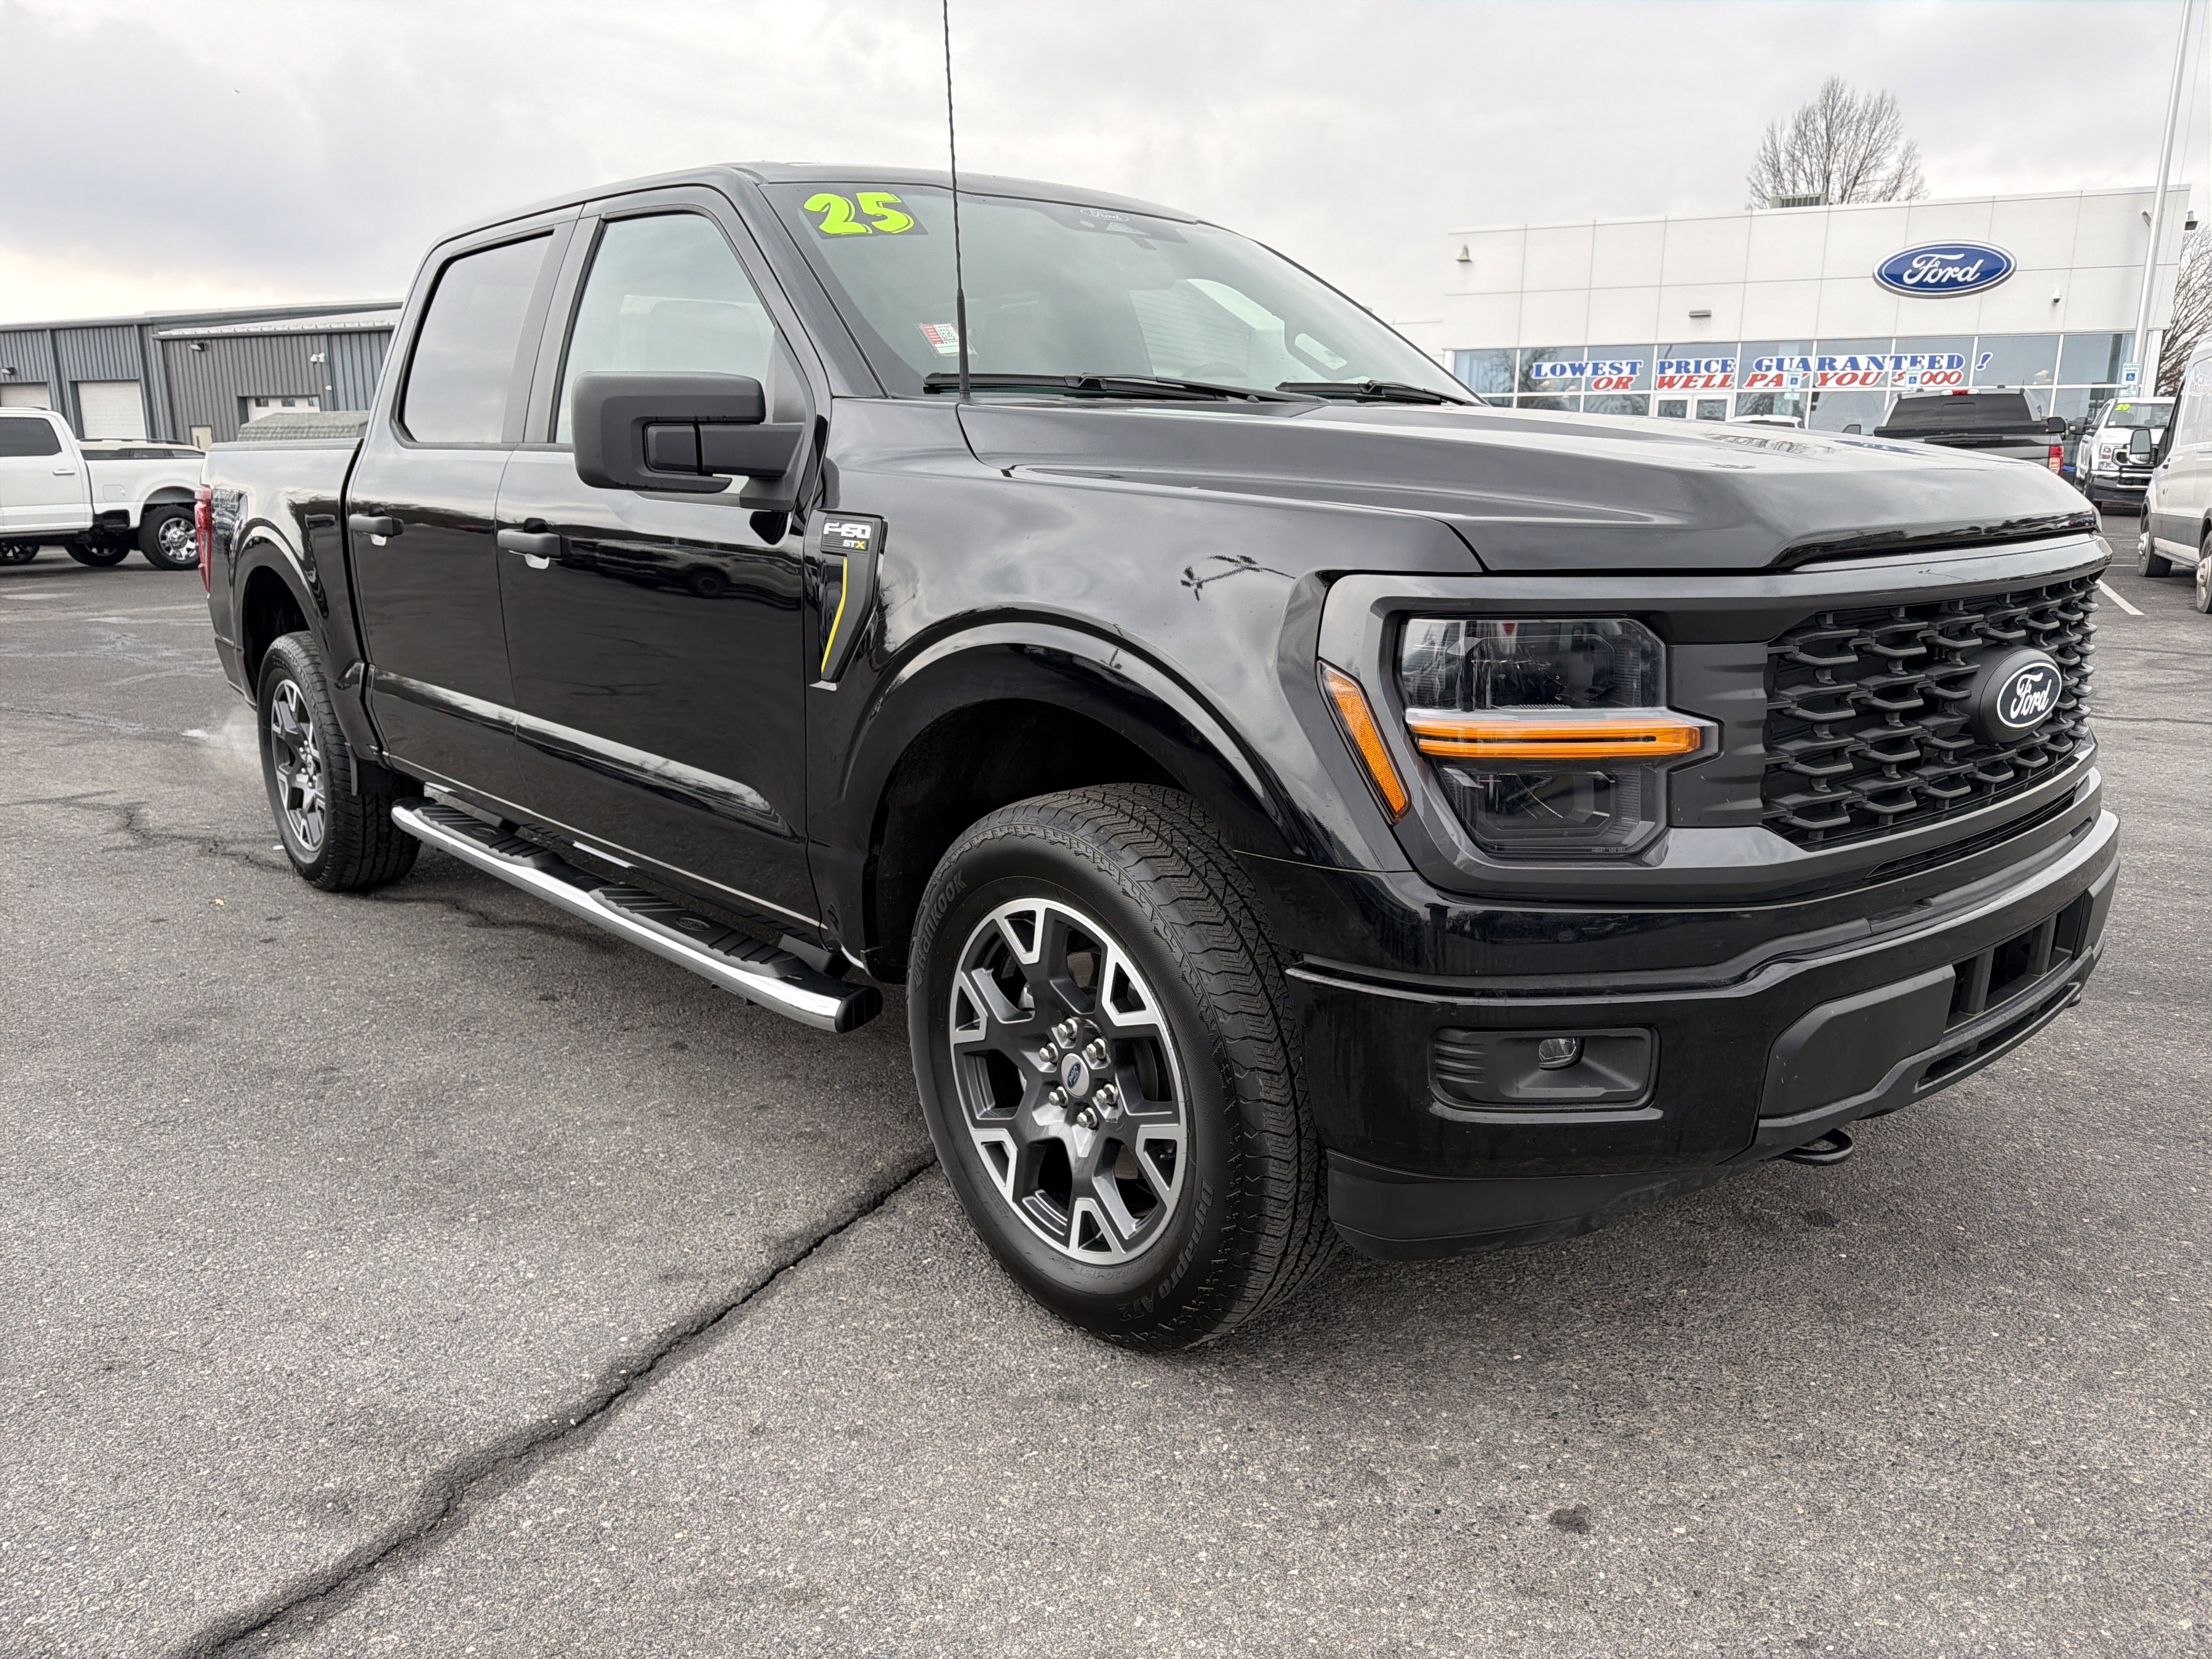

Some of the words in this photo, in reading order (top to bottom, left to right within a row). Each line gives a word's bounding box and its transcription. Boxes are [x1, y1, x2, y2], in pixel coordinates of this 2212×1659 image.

[804, 192, 915, 234] 25
[1903, 253, 1984, 285] Ford
[1533, 360, 1643, 378] LOWEST
[1657, 358, 1735, 375] PRICE
[1754, 354, 1965, 371] GUARANTEED
[1593, 376, 1635, 390] OR
[1743, 371, 1808, 387] PA
[1816, 371, 1883, 387] YOU
[1891, 371, 1962, 385] $000
[843, 539, 866, 549] STX
[2010, 672, 2052, 719] Ford
[1068, 1065, 1079, 1085] Ford
